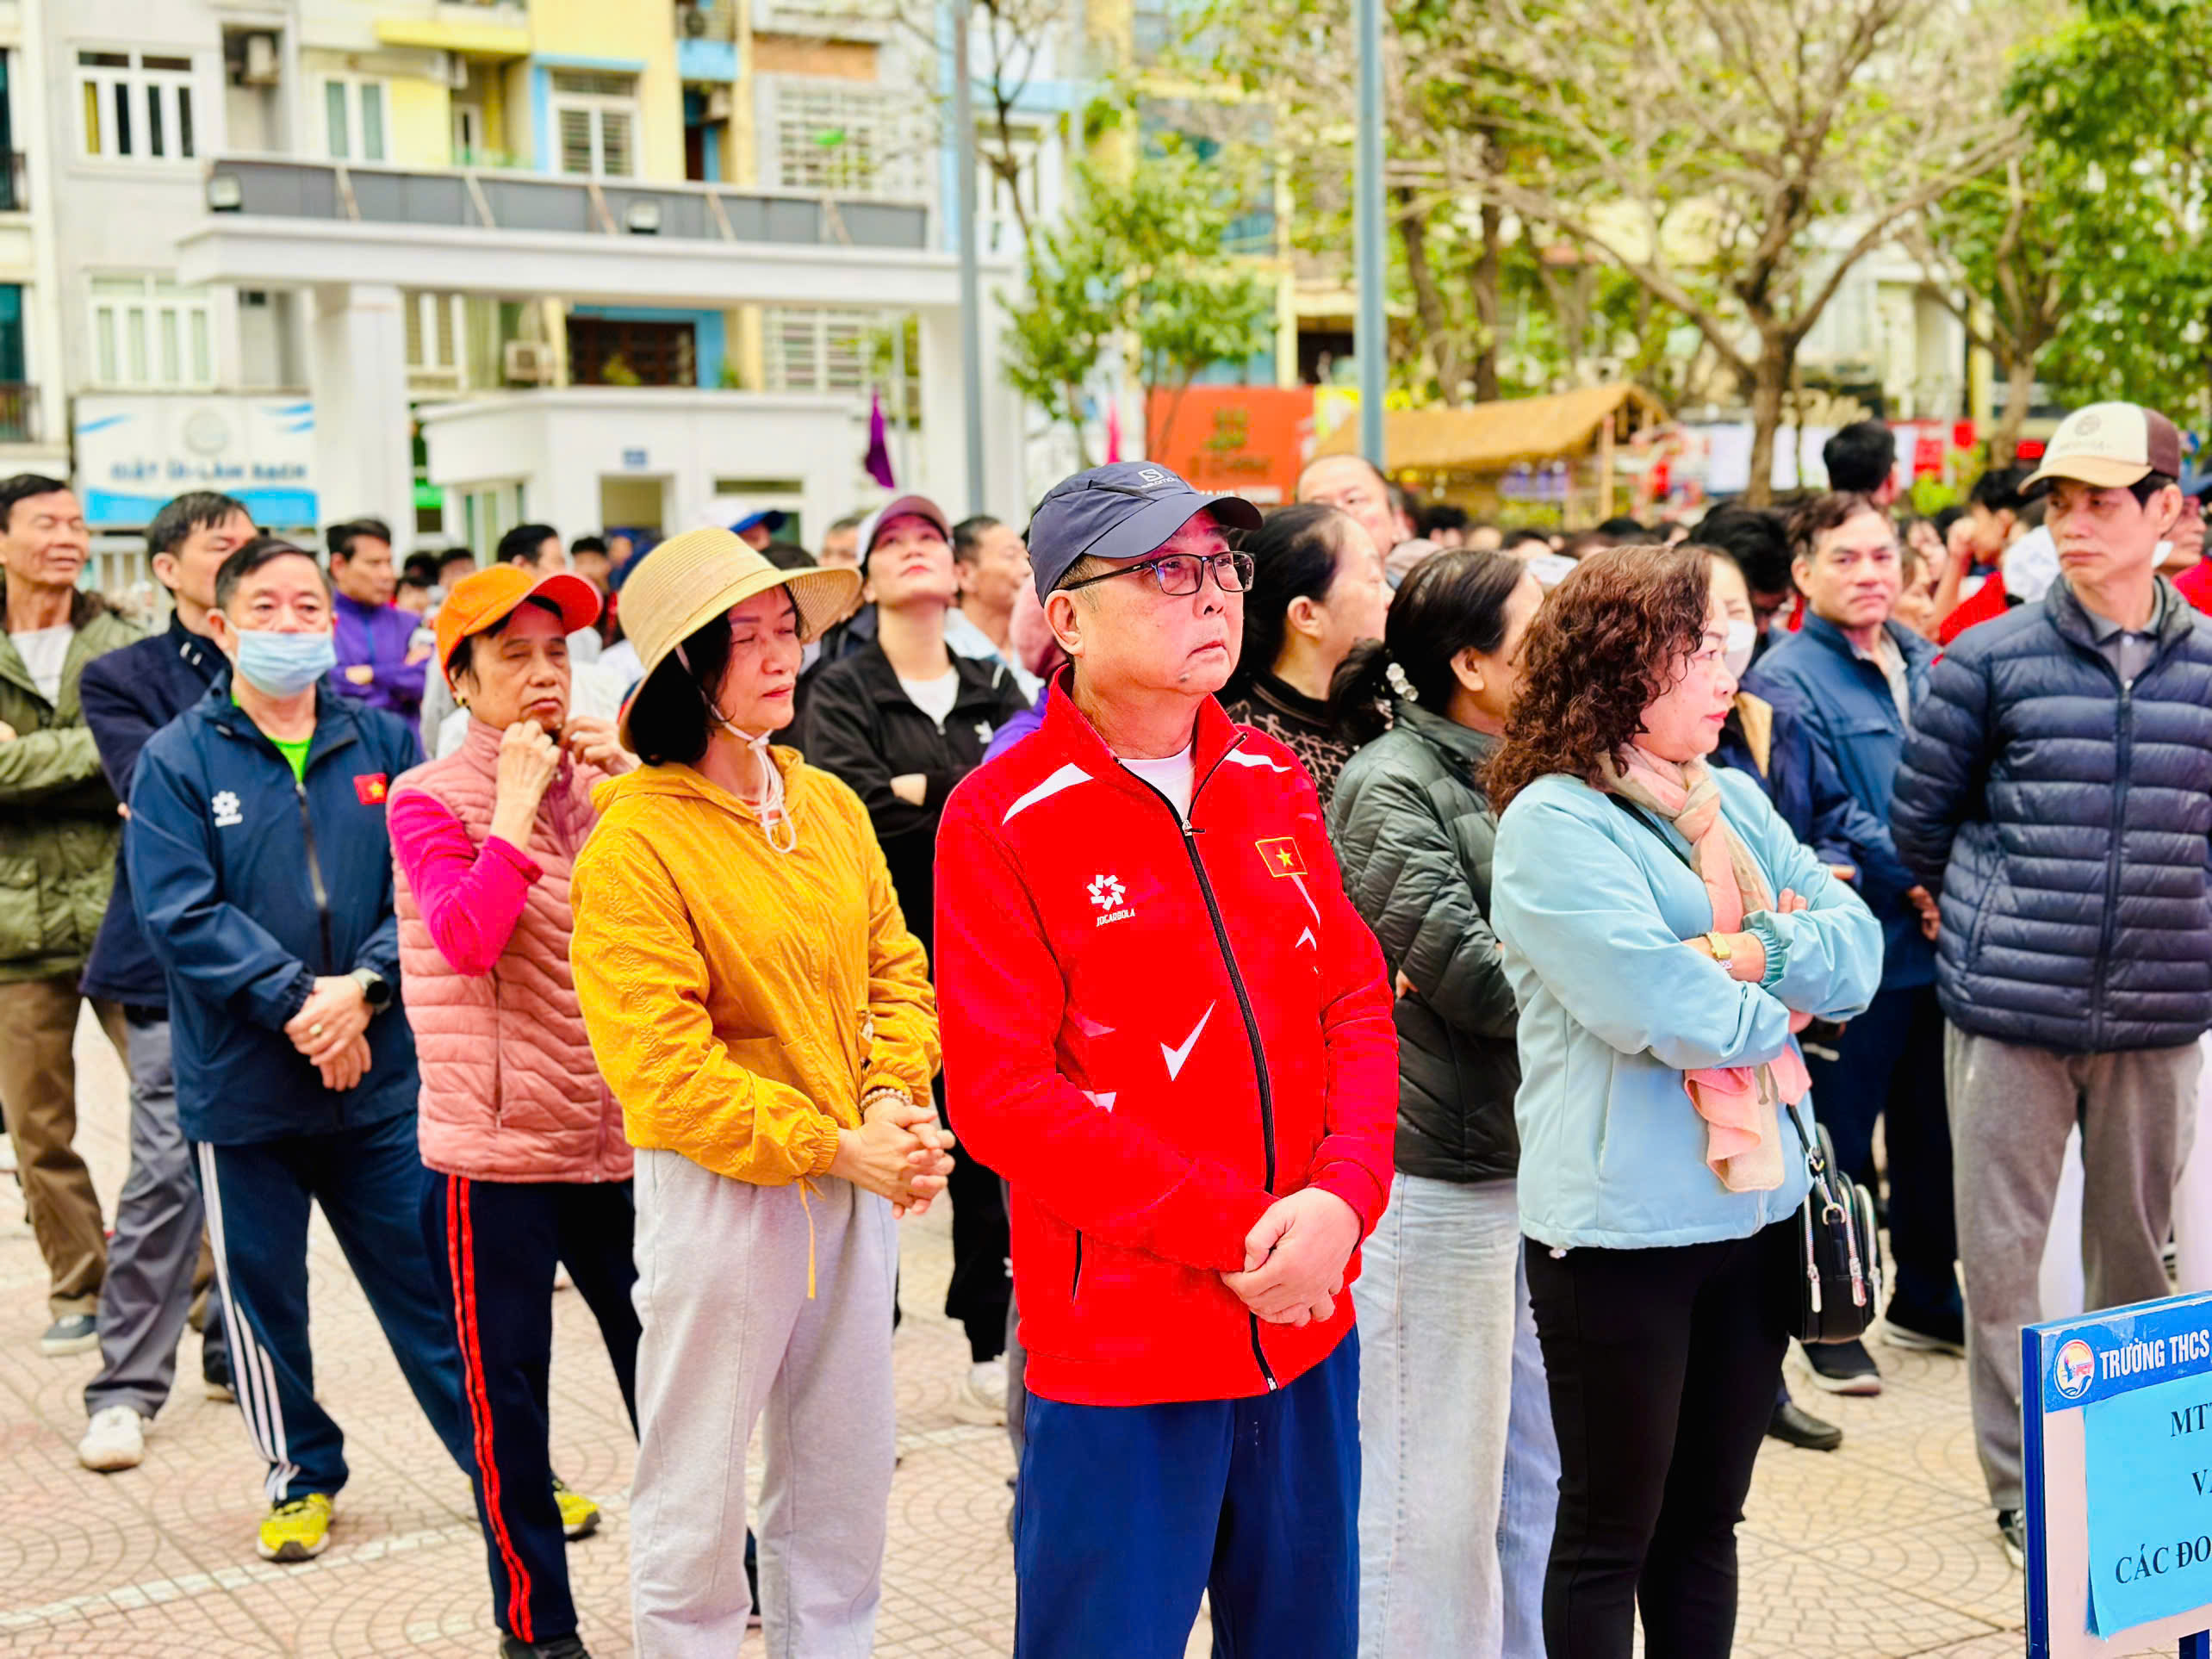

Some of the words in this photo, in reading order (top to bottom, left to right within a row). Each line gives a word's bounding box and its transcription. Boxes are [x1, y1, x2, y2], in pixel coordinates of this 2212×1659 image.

[2099, 1337, 2165, 1380] TRƯỜNG
[2169, 1329, 2210, 1364] THCS
[2170, 1401, 2212, 1438] MT
[2190, 1469, 2212, 1496] V
[2115, 1543, 2169, 1584] CÁC
[2175, 1535, 2212, 1569] ĐO
